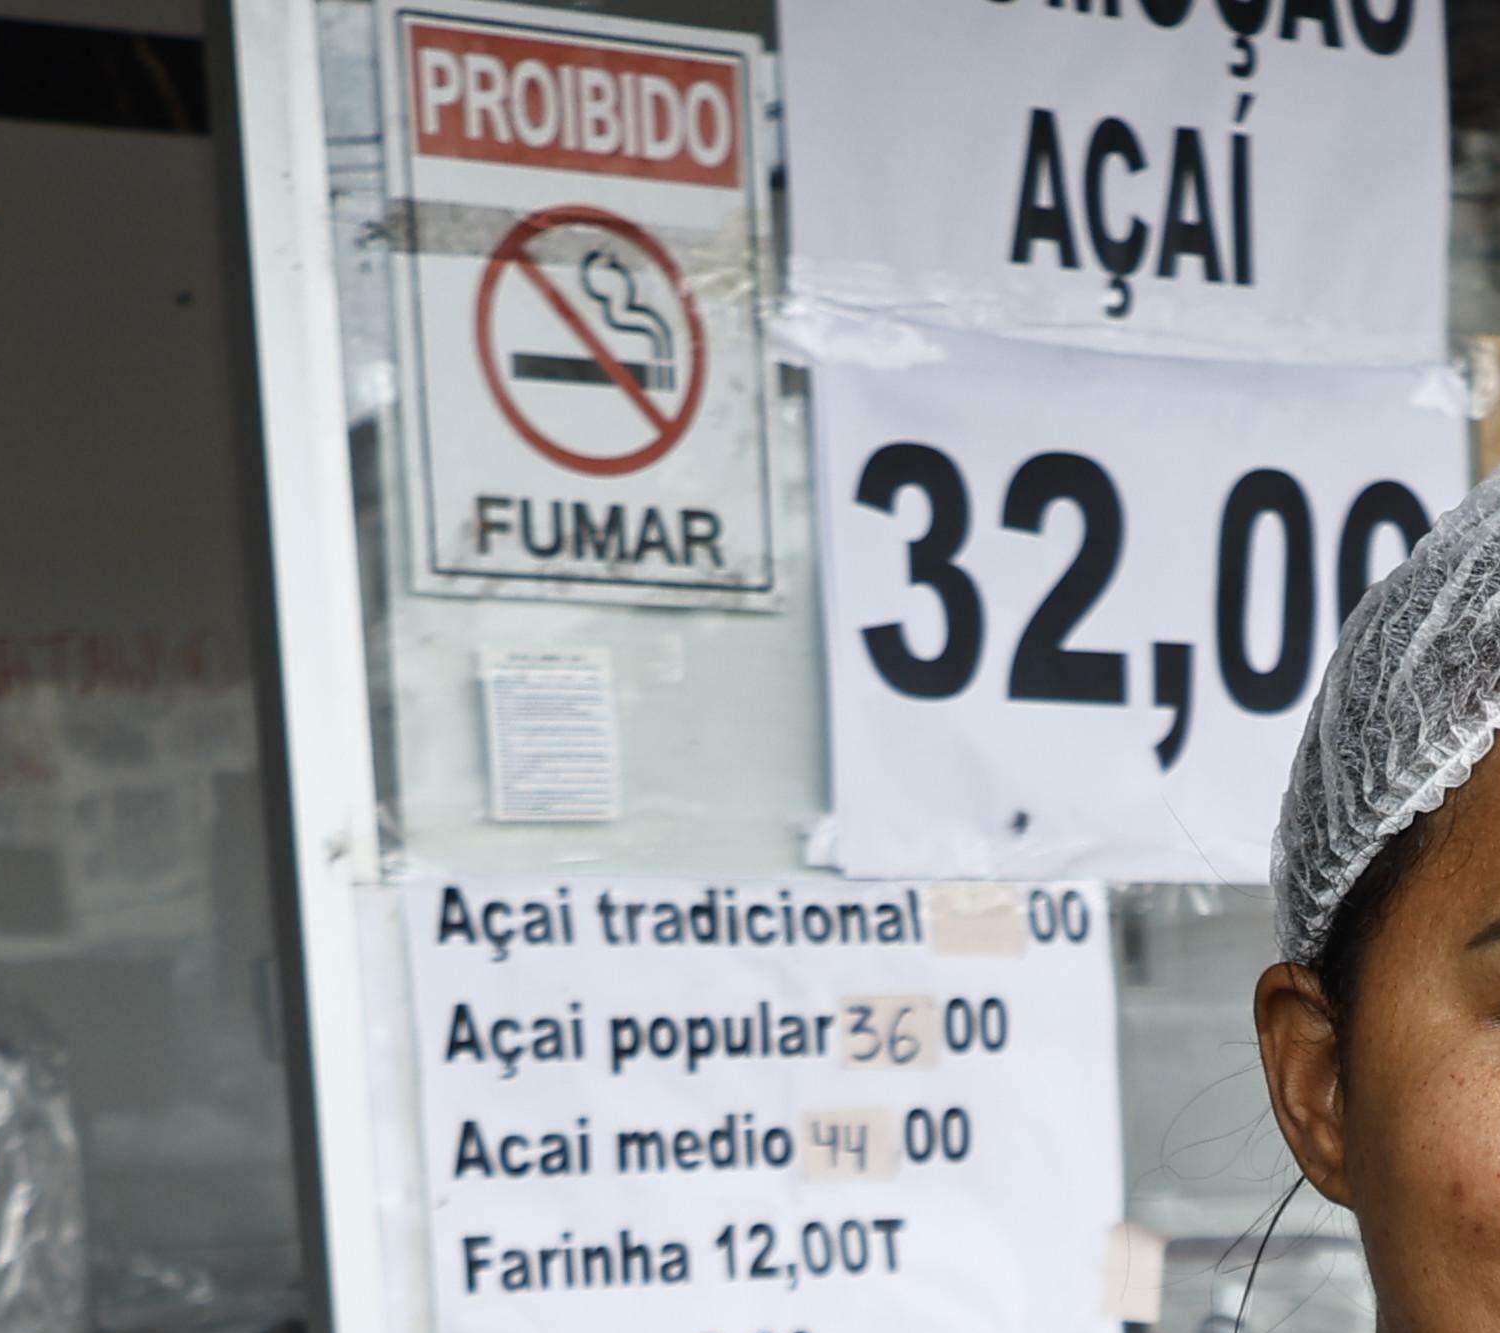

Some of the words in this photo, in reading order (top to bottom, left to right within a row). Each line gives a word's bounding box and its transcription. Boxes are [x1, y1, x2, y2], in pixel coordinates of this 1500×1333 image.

[419, 45, 734, 171] PROIBIDO
[1008, 92, 1255, 318] AÇAÍ
[475, 494, 725, 568] FUMAR
[437, 885, 574, 961] Açai
[596, 888, 922, 946] tradicional
[1027, 888, 1091, 945] 00
[445, 1001, 584, 1079] Açai
[609, 1001, 834, 1074] popular
[943, 996, 1009, 1054] 00
[616, 1113, 795, 1173] medio
[904, 1106, 972, 1164] 00
[461, 1228, 690, 1293] Farinha
